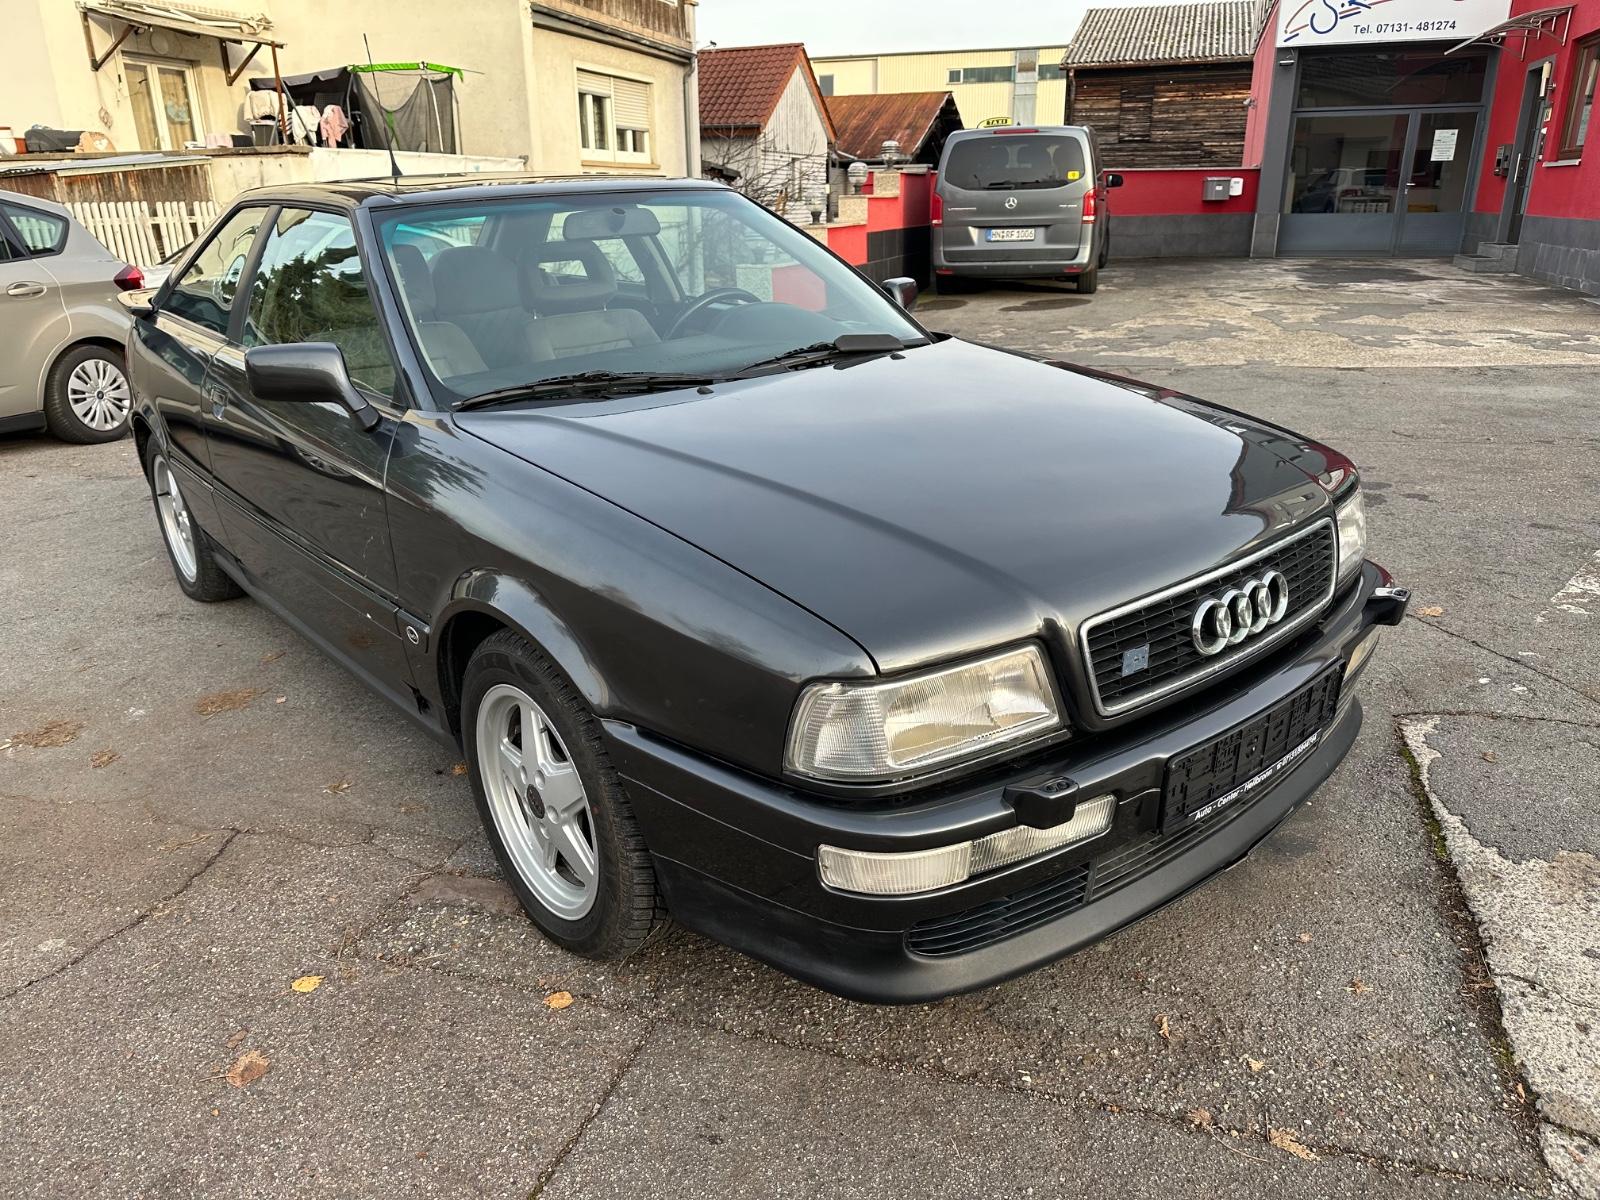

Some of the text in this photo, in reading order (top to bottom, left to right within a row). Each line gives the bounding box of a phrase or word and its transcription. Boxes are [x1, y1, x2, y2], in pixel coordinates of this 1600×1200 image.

[1353, 24, 1372, 34] Tel.
[1416, 20, 1456, 32] 481274
[1195, 806, 1212, 820] Auto
[1217, 790, 1239, 807] Center
[1244, 769, 1273, 792] Heilbronn
